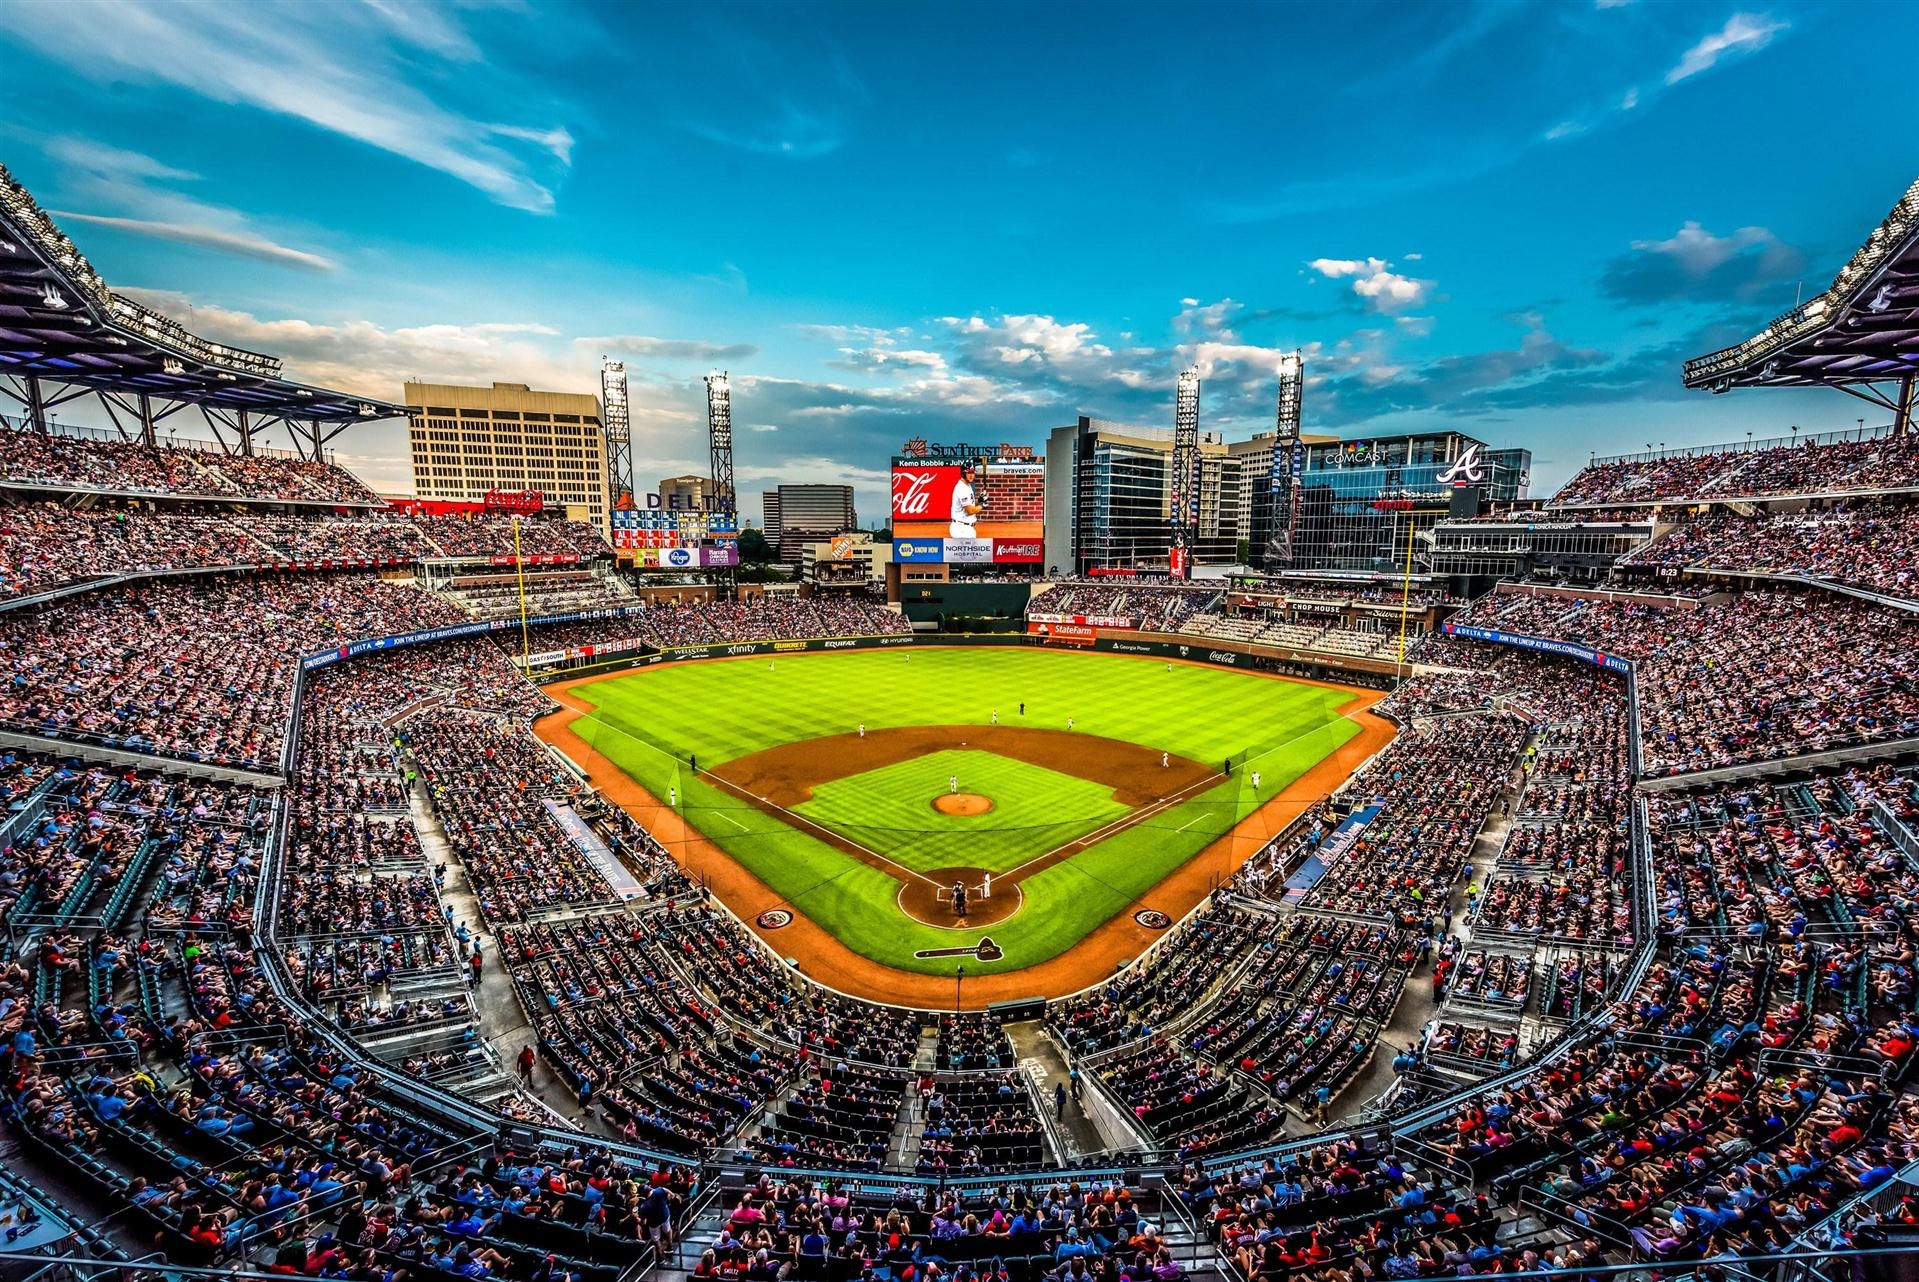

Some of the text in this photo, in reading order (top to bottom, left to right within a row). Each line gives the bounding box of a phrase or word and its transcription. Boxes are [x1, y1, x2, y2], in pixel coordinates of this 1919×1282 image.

[1325, 451, 1389, 465] COMCAST
[1003, 467, 1043, 475] braves.com
[647, 493, 730, 510] DELTA
[1661, 568, 1677, 577] 8:23
[1292, 603, 1340, 613] CHOP HOUSE
[414, 634, 430, 642] LINEUP
[1518, 638, 1535, 646] LINEUP
[354, 643, 372, 653] DELTA
[825, 640, 856, 648] EQUIFAX
[728, 644, 757, 655] xfinity
[1209, 650, 1236, 664] Coca-Cola
[1610, 660, 1629, 671] DELTA
